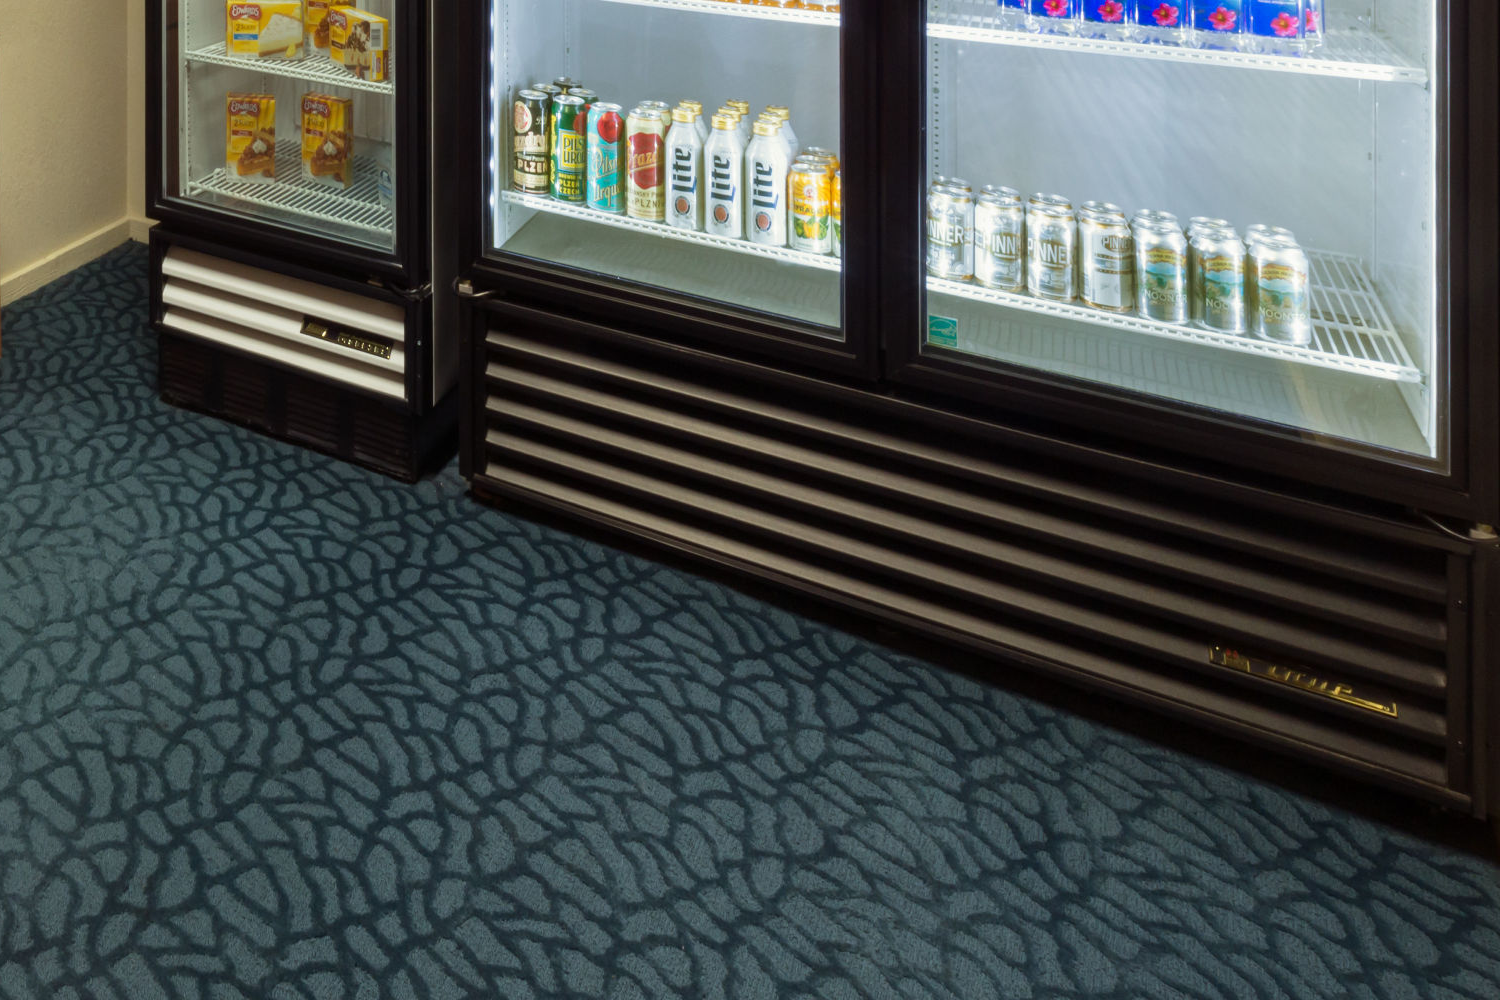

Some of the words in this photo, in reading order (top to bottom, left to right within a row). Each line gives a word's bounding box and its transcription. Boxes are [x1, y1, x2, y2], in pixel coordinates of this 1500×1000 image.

[231, 4, 260, 17] EDWARDS
[231, 100, 258, 113] EDWARDS
[672, 146, 697, 194] Lite
[710, 154, 736, 203] Lite
[752, 161, 779, 209] Lite
